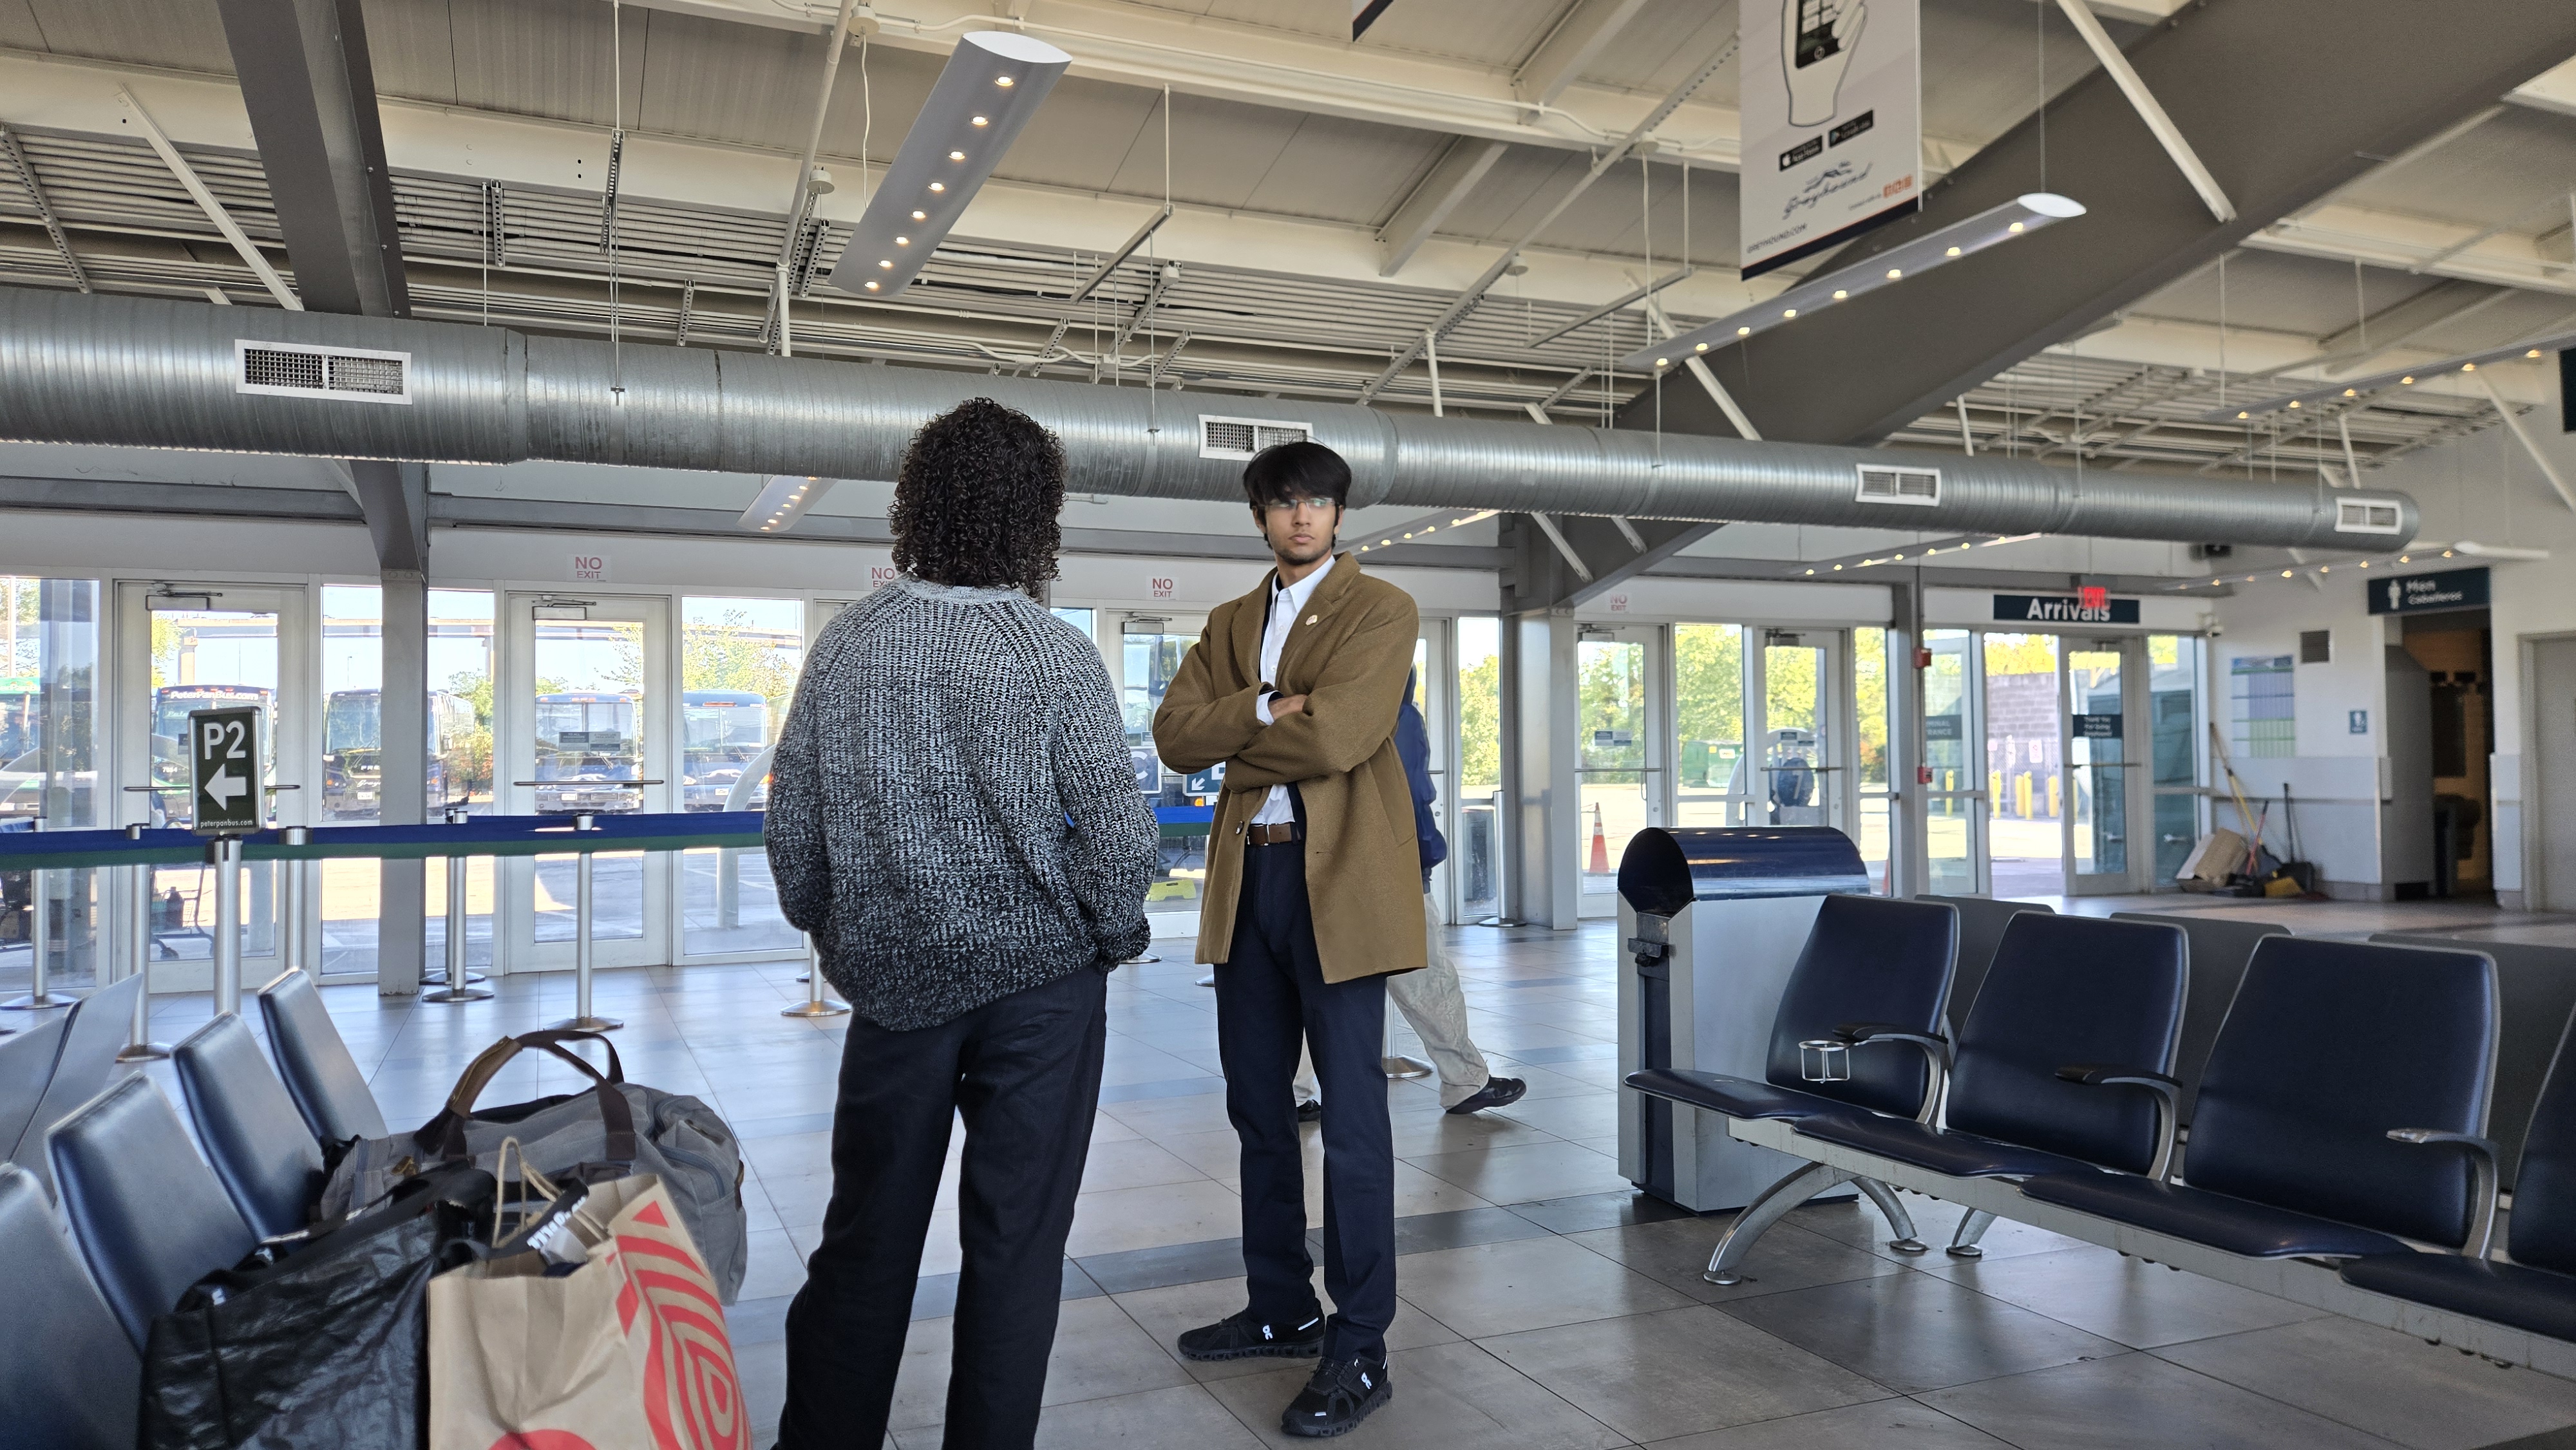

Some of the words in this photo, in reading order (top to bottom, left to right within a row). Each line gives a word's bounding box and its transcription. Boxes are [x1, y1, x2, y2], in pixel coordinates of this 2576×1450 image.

[575, 556, 602, 570] NO
[576, 570, 601, 579] EXIT
[871, 567, 895, 580] NO
[1153, 578, 1173, 590] NO
[2406, 579, 2436, 593] Men
[1610, 594, 1627, 604] NO
[2026, 598, 2110, 622] Arrivals
[170, 690, 259, 700] PeterPanBus.com
[204, 720, 246, 760] P2
[200, 819, 253, 829] peterpanbus.com
